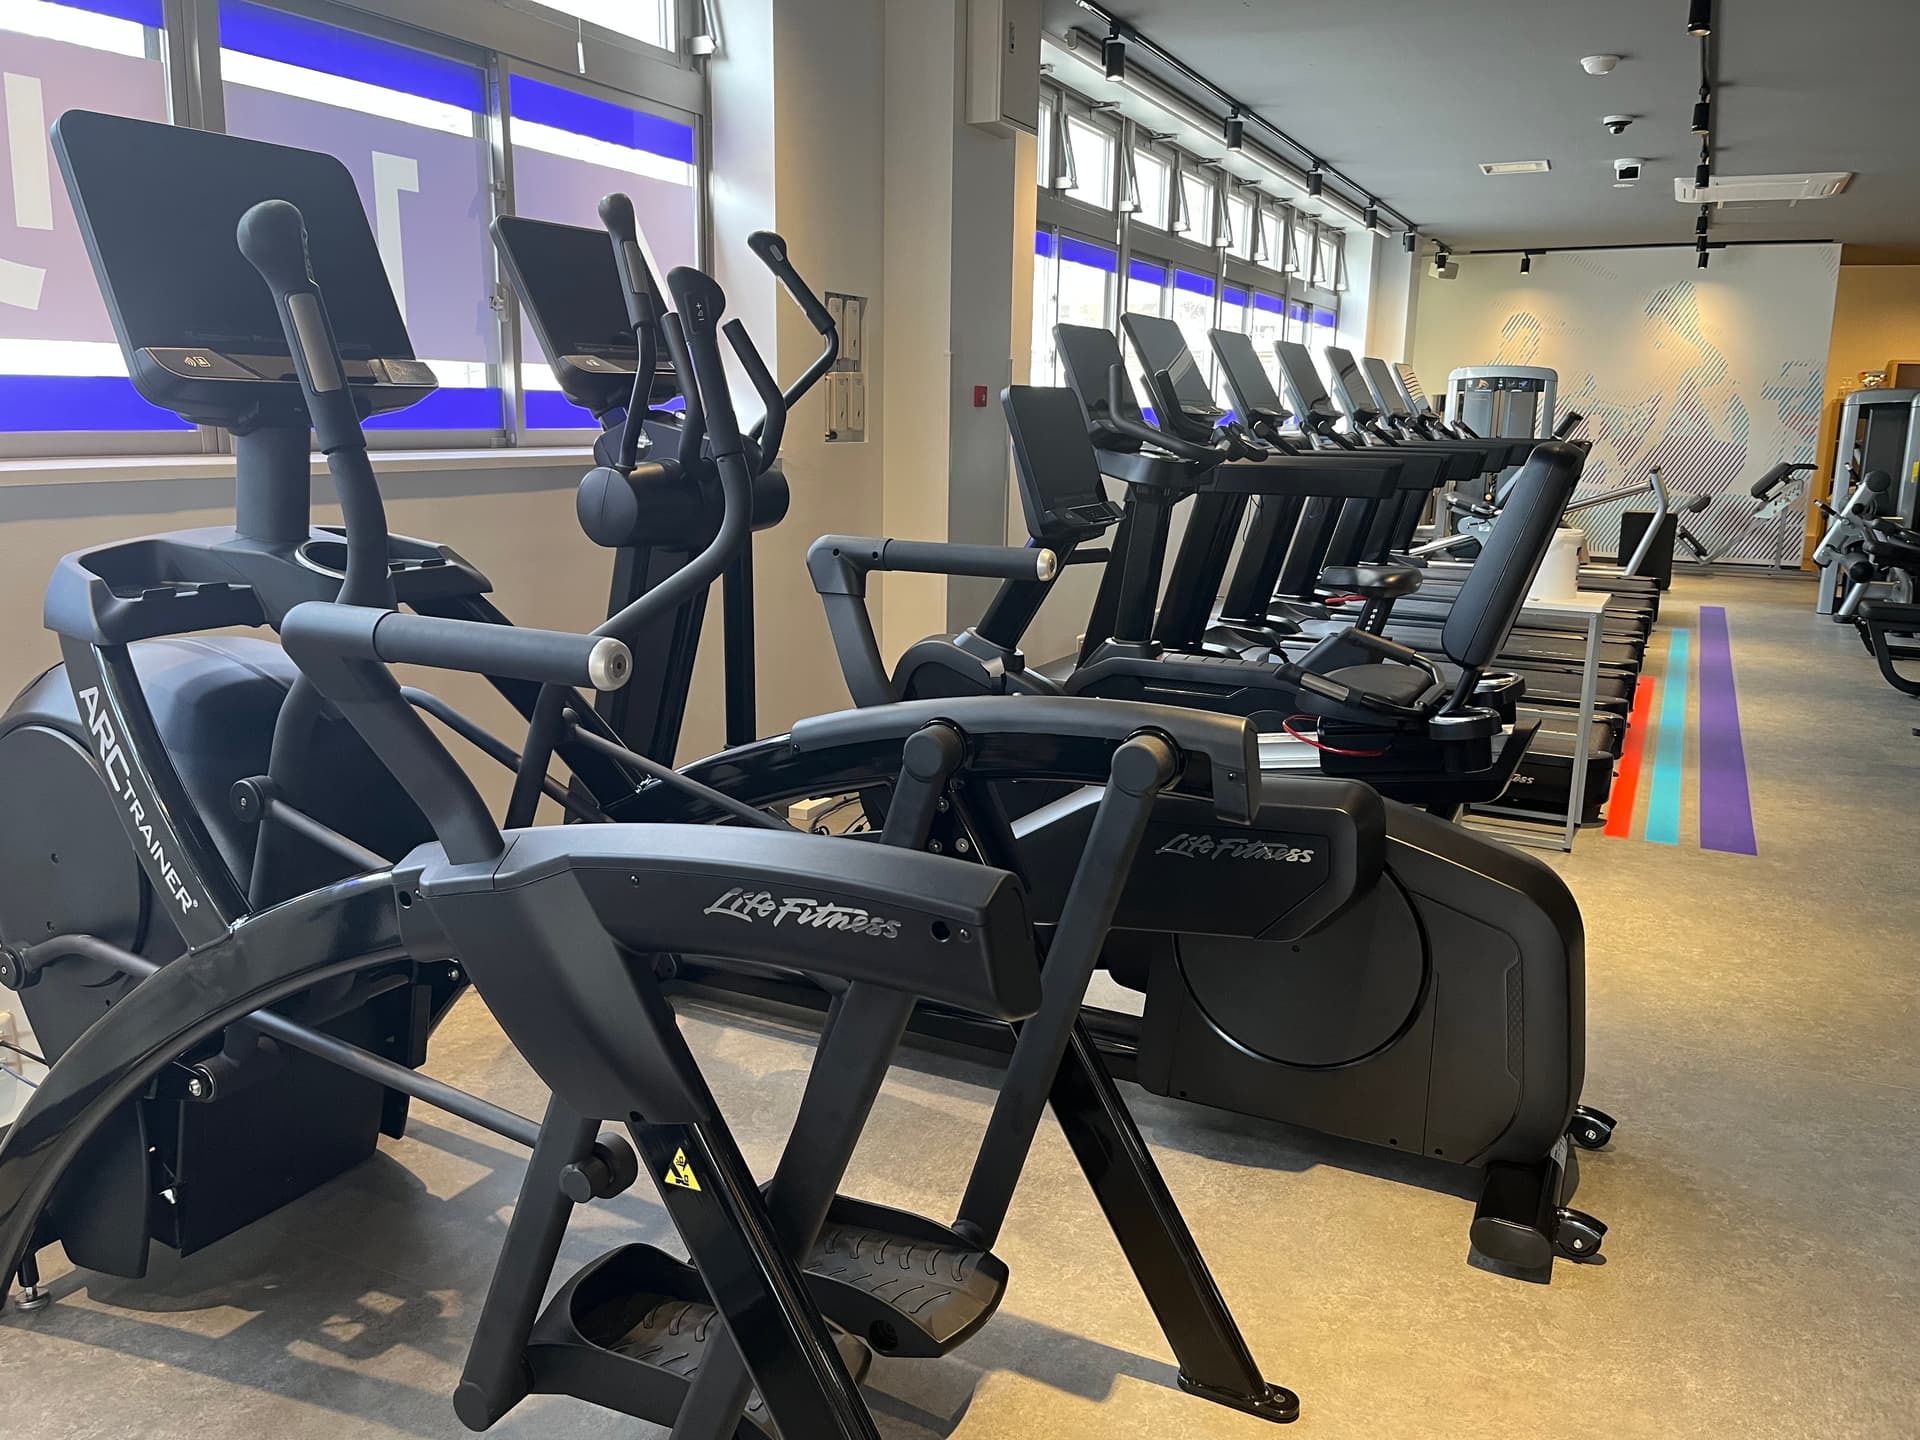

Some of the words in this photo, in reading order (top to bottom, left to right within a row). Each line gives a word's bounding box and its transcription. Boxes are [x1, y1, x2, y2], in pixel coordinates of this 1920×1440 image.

[79, 686, 131, 792] ARC
[1155, 833, 1215, 858] Life
[1211, 838, 1315, 863] Fitness
[704, 887, 776, 923] Life
[773, 898, 902, 939] Fitness
